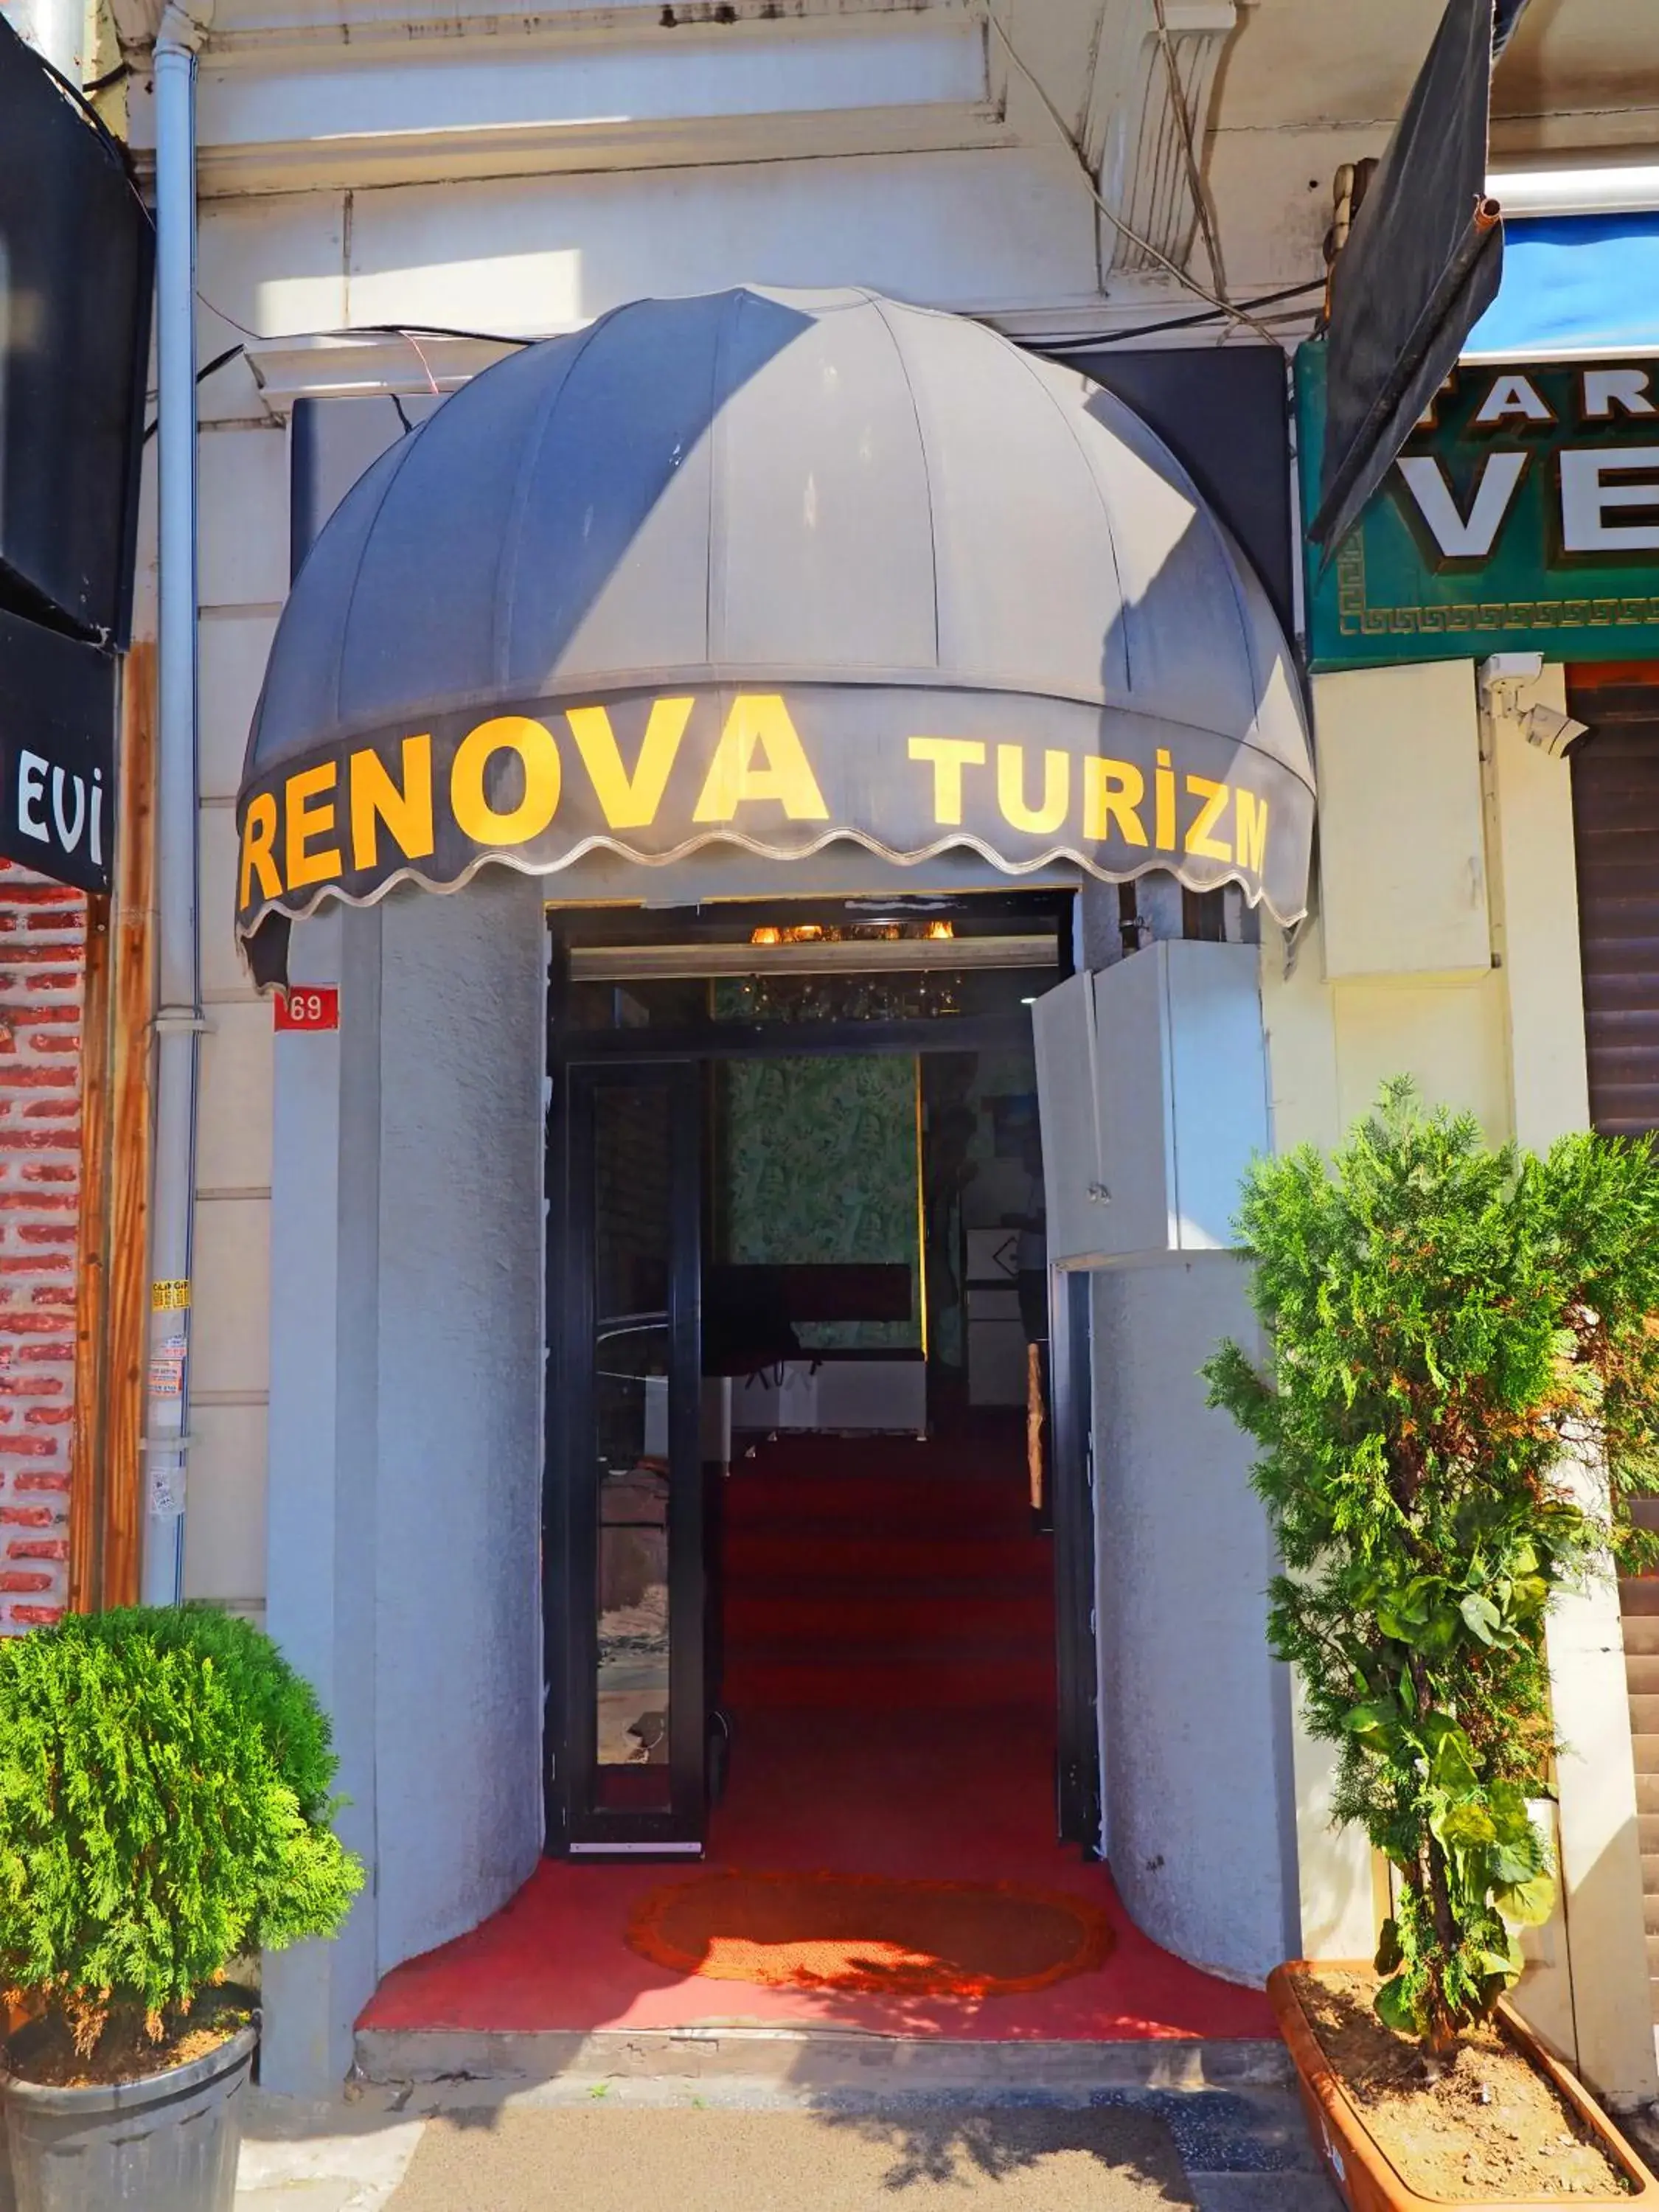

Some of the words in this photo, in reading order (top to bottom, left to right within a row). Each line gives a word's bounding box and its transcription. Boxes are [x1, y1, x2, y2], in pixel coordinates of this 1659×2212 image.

[1416, 369, 1659, 423] AR
[240, 695, 829, 911] RENOVA
[908, 737, 1268, 880] TURİZM
[290, 996, 321, 1020] 69
